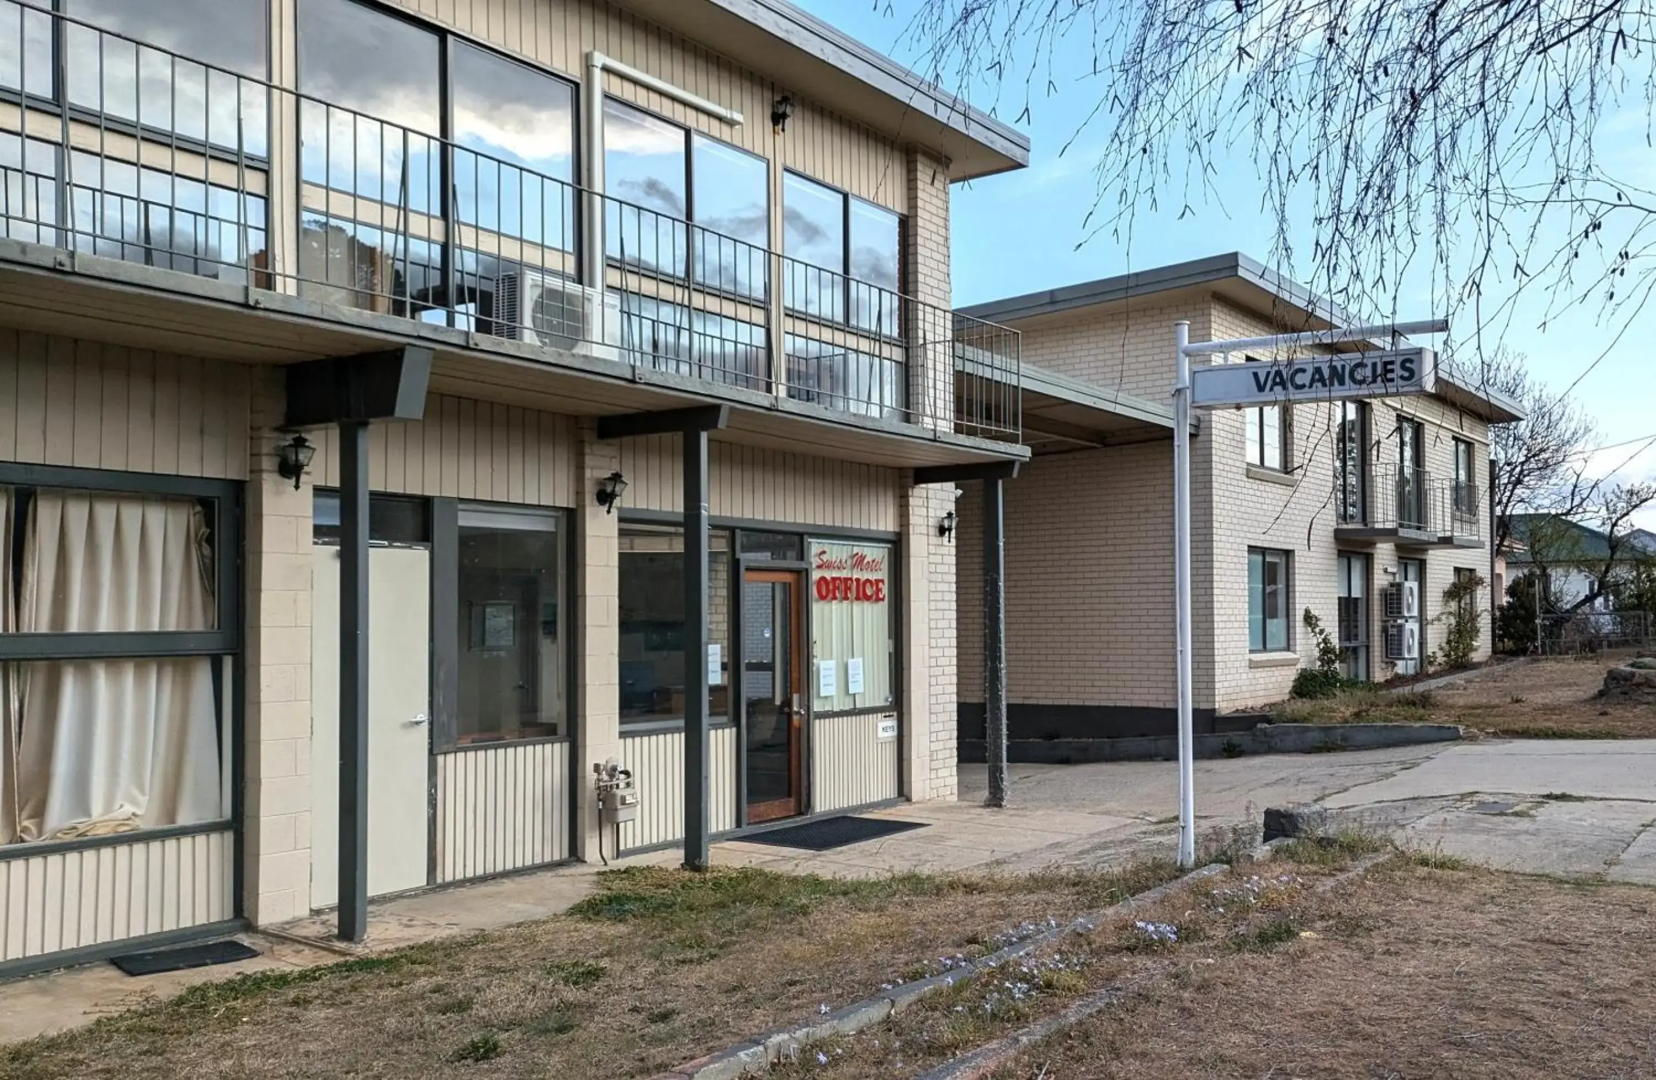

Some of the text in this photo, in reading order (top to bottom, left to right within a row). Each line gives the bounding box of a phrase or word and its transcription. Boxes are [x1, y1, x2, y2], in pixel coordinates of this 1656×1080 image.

[1252, 358, 1416, 393] VACANCIES
[816, 550, 885, 572] Swiss Motel
[816, 576, 886, 602] OFFICE
[881, 725, 896, 733] KEYS
